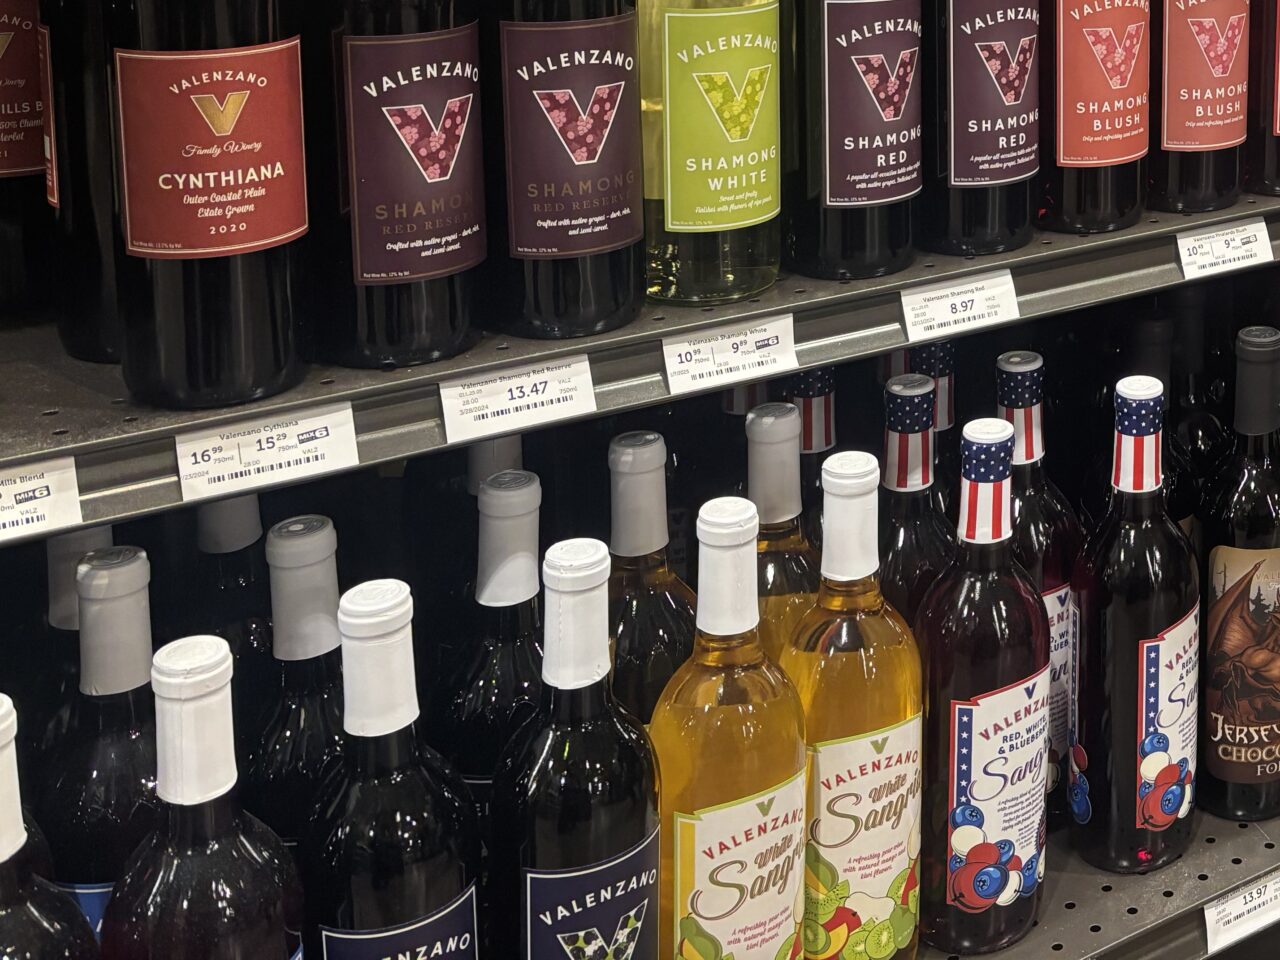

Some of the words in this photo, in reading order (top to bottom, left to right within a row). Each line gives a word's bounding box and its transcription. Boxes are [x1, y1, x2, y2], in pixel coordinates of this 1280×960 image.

[677, 34, 778, 63] VALENZANO
[518, 49, 634, 81] VALENZANO
[168, 69, 268, 95] VALENZANO
[364, 61, 479, 98] VALENZANO
[1179, 81, 1247, 100] SHAMONG
[1076, 92, 1147, 114] SHAMONG
[1196, 100, 1241, 117] BLUSH
[968, 107, 1039, 132] SHAMONG
[1093, 113, 1140, 131] BLUSH
[844, 125, 921, 150] SHAMONG
[999, 132, 1026, 149] RED
[182, 144, 221, 159] Family
[223, 140, 262, 157] Winery
[686, 145, 776, 172] SHAMONG
[877, 150, 907, 167] RED
[158, 161, 285, 190] CYNTHIANA
[527, 170, 634, 198] SHAMONG
[708, 169, 767, 191] WHITE
[183, 192, 209, 205] Outer
[210, 190, 242, 203] Coastal
[244, 186, 266, 200] Plain
[197, 206, 223, 219] Estate
[225, 203, 255, 219] Grown
[533, 201, 565, 213] RED
[209, 223, 247, 235] 2020
[382, 222, 417, 236] RED
[950, 299, 975, 314] 8.97
[460, 377, 497, 391] Valenzano
[499, 371, 530, 384] Shamong
[532, 367, 545, 376] Red
[546, 362, 572, 373] Reserve
[507, 380, 549, 401] 13.47
[219, 426, 262, 441] Valenzano
[263, 418, 299, 435] Cythiana
[19, 471, 45, 485] Blend
[1002, 731, 1024, 744] RED,
[1025, 714, 1047, 735] WHITE
[998, 746, 1006, 755] &
[821, 750, 919, 791] VALENZANO
[869, 773, 907, 804] White
[702, 807, 804, 860] VALENZANO
[754, 833, 793, 870] White
[540, 868, 657, 926] VALENZANO
[1242, 884, 1268, 906] 13.97
